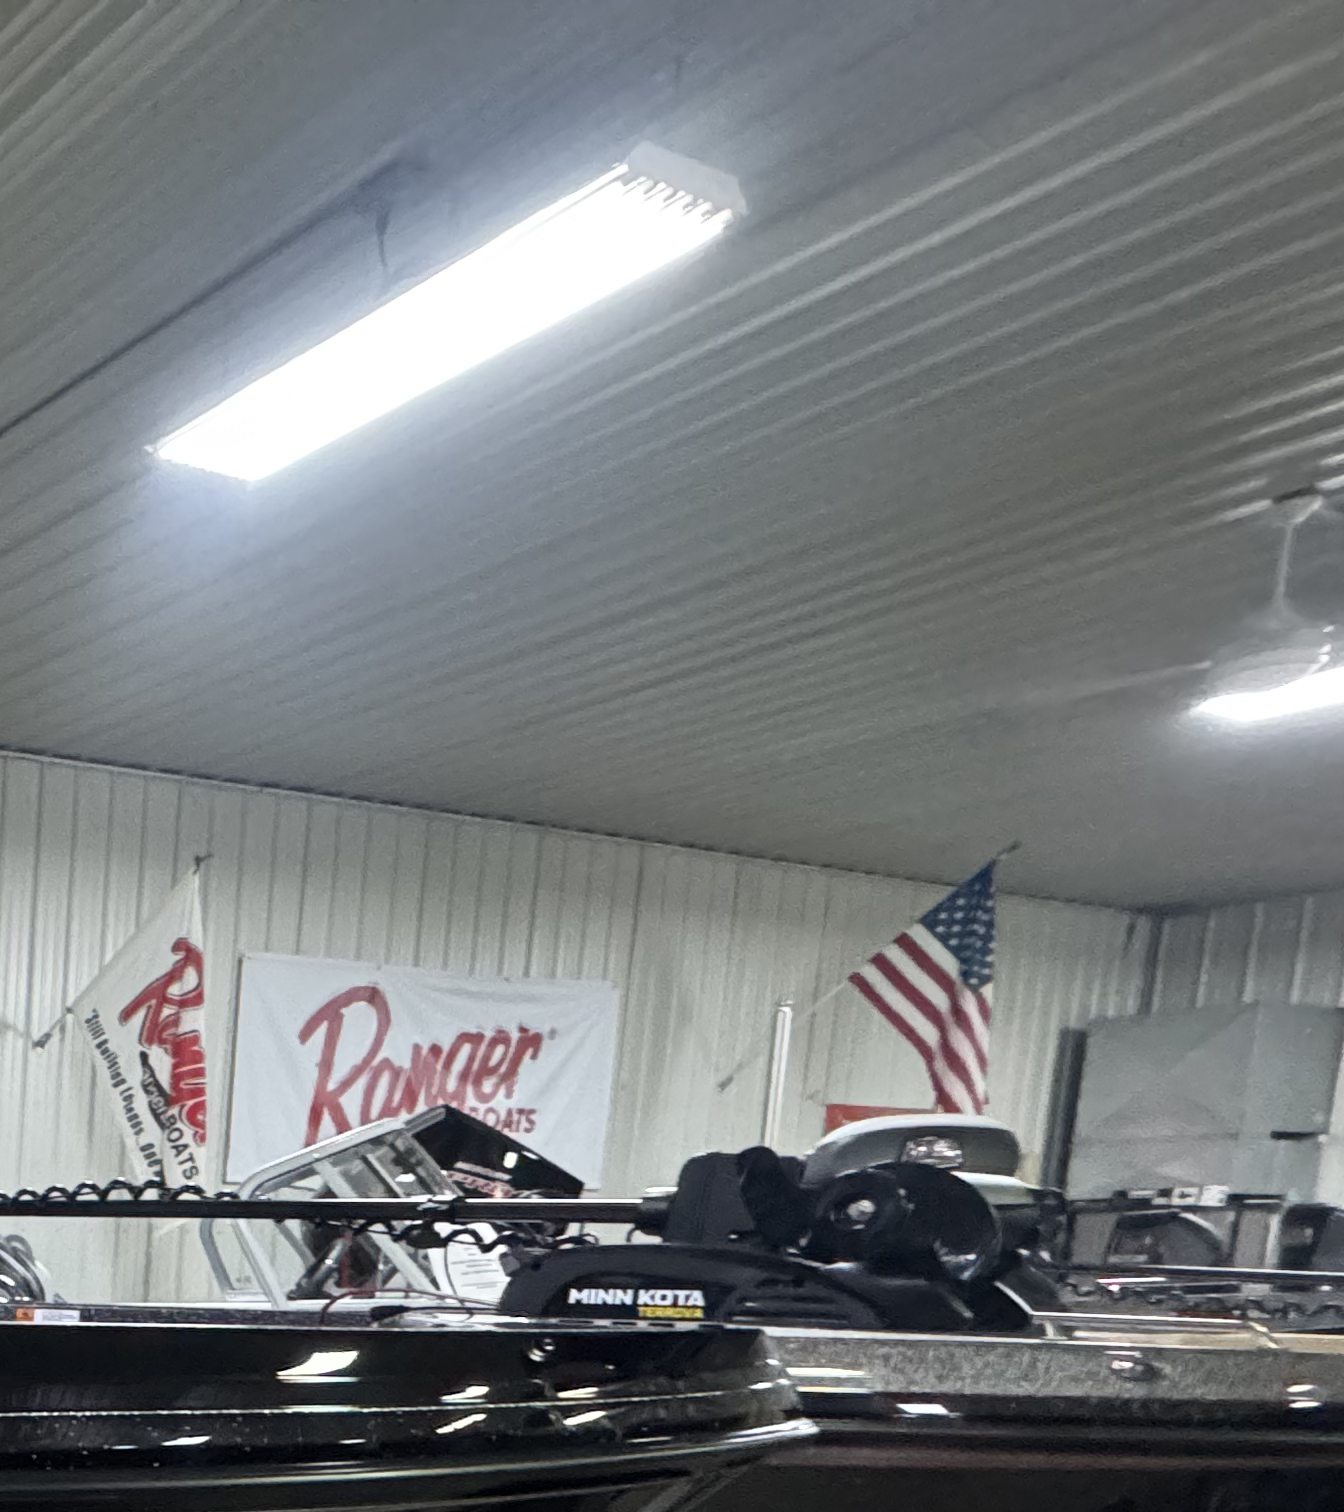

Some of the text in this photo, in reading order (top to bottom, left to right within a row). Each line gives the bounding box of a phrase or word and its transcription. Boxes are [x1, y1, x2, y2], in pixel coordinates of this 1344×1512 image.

[298, 985, 543, 1147] Ranger
[567, 1287, 706, 1306] MINN KOTA
